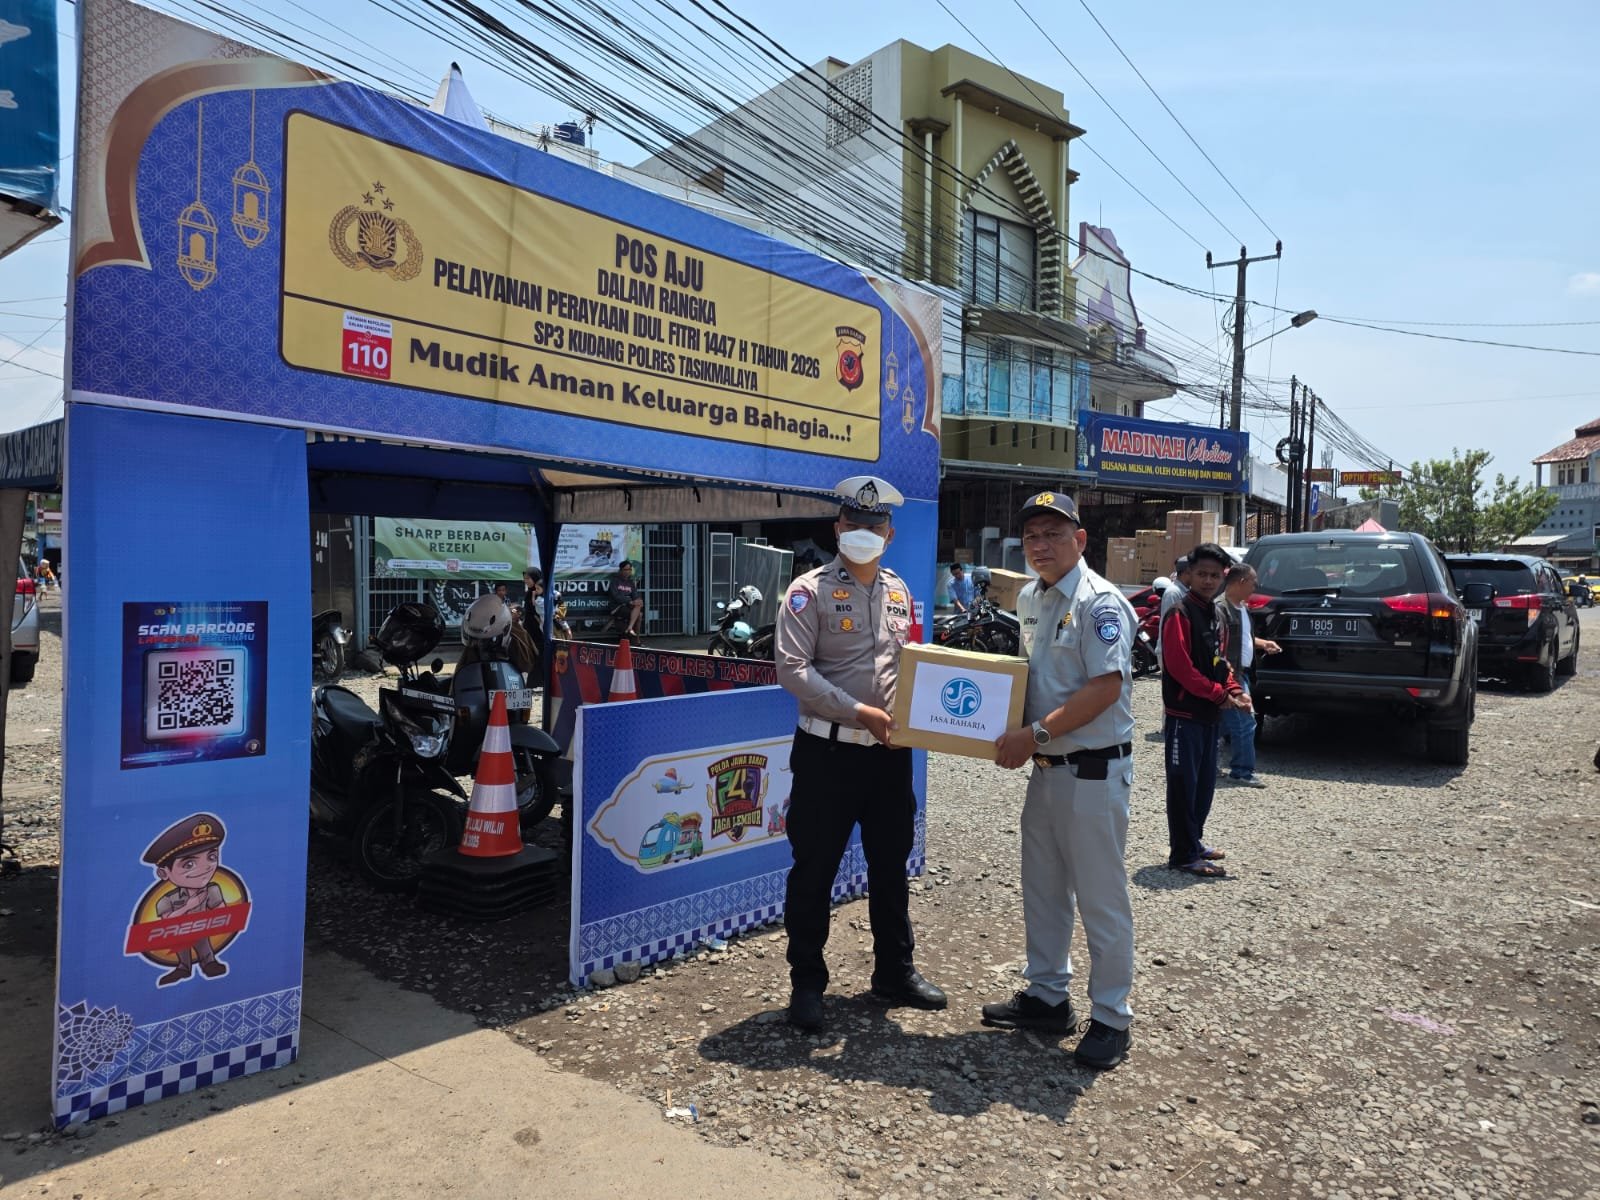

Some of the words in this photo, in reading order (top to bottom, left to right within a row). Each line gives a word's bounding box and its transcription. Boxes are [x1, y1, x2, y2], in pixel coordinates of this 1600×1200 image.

[615, 233, 658, 279] POS
[664, 250, 704, 292] AJU
[597, 268, 655, 310] DALAM
[659, 287, 717, 327] RANGKA
[433, 257, 542, 313] PELAYANAN
[547, 288, 629, 335] PERAYAAN
[633, 312, 664, 344] IDUL
[669, 321, 700, 352] FITRI
[704, 330, 736, 360] 1447
[739, 339, 748, 363] H
[751, 342, 788, 372] TAHUN
[791, 352, 820, 379] 2026
[348, 342, 388, 370] 110
[534, 320, 565, 349] SP3
[568, 328, 624, 363] KUDANG
[628, 343, 675, 374] POLRES
[679, 355, 758, 392] TASIKMALAYA
[409, 338, 520, 384] Mudik
[528, 363, 614, 401] Aman
[622, 381, 738, 426] Keluarga
[744, 405, 852, 443] Bahagia...!
[24, 423, 57, 478] CABANG
[1101, 427, 1187, 461] MADINAH
[1186, 436, 1233, 466] Collection
[1101, 461, 1127, 472] BUSANA
[1155, 466, 1171, 475] OLEH
[1171, 467, 1186, 477] OLEH
[1187, 469, 1199, 480] HAJI
[1199, 470, 1211, 479] DAN
[1211, 470, 1232, 481] UMROH
[1343, 473, 1364, 482] OPTIK
[1312, 488, 1318, 511] P
[395, 527, 442, 540] SHARP
[447, 529, 506, 542] BERBAGI
[429, 542, 475, 554] REZEKI
[835, 604, 853, 613] RIO
[138, 624, 181, 636] SCAN
[186, 622, 255, 634] BARCODE
[1291, 619, 1298, 630] D
[1310, 619, 1333, 631] 1805
[579, 646, 604, 665] SAT
[605, 649, 656, 671] LATAS
[658, 657, 714, 679] POLRES
[930, 715, 949, 724] JASA
[950, 718, 986, 731] RAHARJA
[710, 759, 730, 775] POLDA
[730, 755, 747, 767] JAWA
[748, 755, 766, 766] BARAT
[713, 817, 731, 836] JAGA
[147, 913, 232, 942] PRESISI
